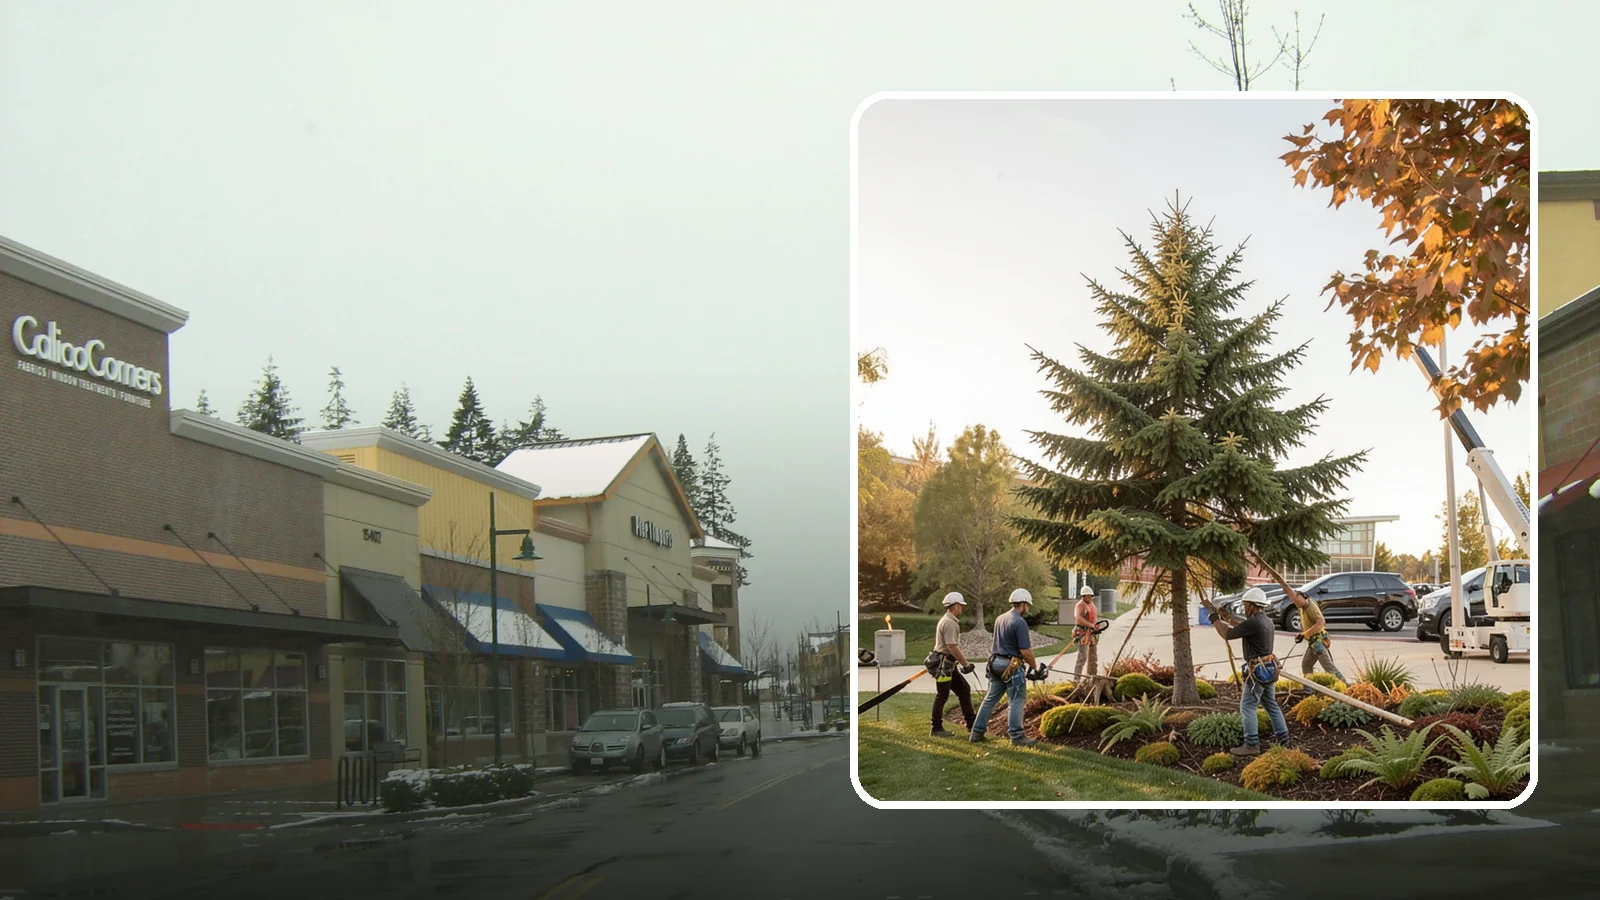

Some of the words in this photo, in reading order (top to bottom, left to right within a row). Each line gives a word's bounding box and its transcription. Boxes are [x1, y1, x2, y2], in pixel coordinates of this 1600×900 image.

[17, 360, 47, 377] FABRICS
[51, 370, 78, 387] WINDOW
[78, 378, 116, 398] TREATMENTS
[120, 391, 151, 409] FURNITURE
